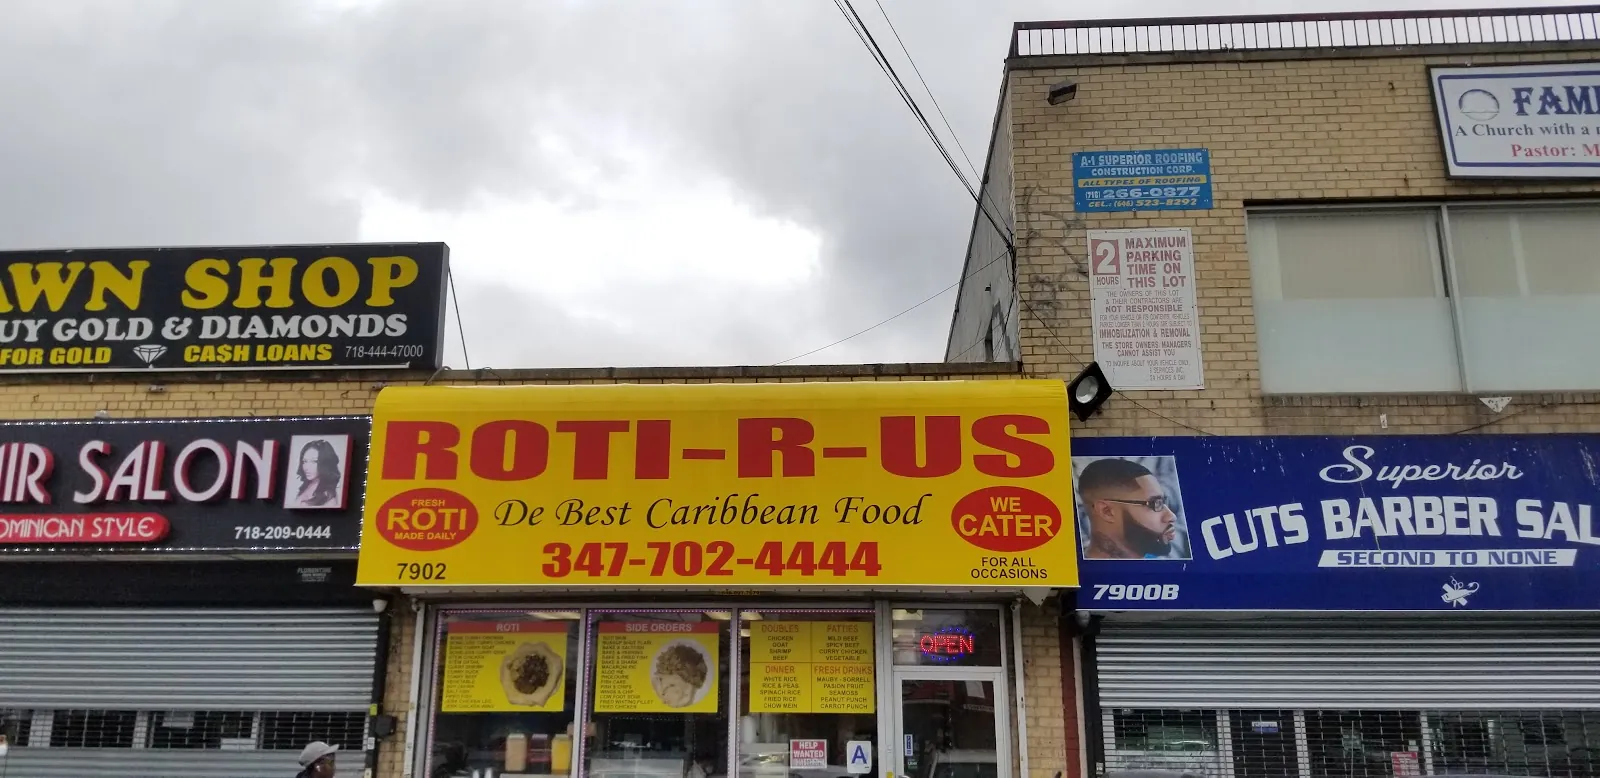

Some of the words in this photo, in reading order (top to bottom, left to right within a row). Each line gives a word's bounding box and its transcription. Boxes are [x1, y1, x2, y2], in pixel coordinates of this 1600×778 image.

[1455, 125, 1468, 137] A
[1472, 124, 1533, 136] Church
[1539, 123, 1575, 136] with
[1581, 126, 1590, 135] a
[1511, 144, 1576, 157] Pastor:
[1099, 153, 1153, 166] SUPERIOR
[1155, 152, 1203, 164] ROOFING
[1091, 166, 1163, 176] CONSTRUCTION
[1166, 165, 1196, 174] CORP.
[1102, 186, 1201, 199] 266-0877
[1136, 198, 1197, 206] 523-8292
[1125, 236, 1186, 249] MAXIMUM
[1096, 241, 1117, 274] 2
[1126, 250, 1182, 262] PARKING
[1126, 263, 1157, 275] TIME
[1163, 262, 1181, 274] ON
[0, 259, 150, 314] WN
[180, 256, 419, 309] SHOP
[1096, 276, 1120, 286] HOURS
[1127, 276, 1156, 288] THIS
[1162, 275, 1187, 288] LOT
[1119, 290, 1143, 298] OWNERS
[1155, 289, 1168, 297] THIS
[1168, 289, 1180, 297] LOT
[1129, 297, 1170, 305] CONTRACTORS
[1105, 305, 1122, 313] NOT
[1126, 304, 1183, 313] RESPONSIBLE
[52, 317, 154, 342] GOLD
[161, 316, 193, 341] &
[198, 313, 408, 340] DIAMONDS
[1099, 328, 1150, 339] IMMOBILIZATION
[1153, 328, 1158, 338] &
[1160, 327, 1191, 338] REMOVAL
[1115, 341, 1133, 349] STORE
[1161, 340, 1192, 348] MANAGERS
[0, 347, 44, 365] FOR
[49, 346, 112, 364] GOLD
[183, 343, 250, 363] CA$H
[255, 343, 333, 362] LOANS
[345, 344, 424, 359] 718-444-47000
[1117, 349, 1139, 357] CANNOT
[1141, 349, 1161, 357] ASSIST
[1164, 348, 1176, 356] YOU
[380, 413, 1056, 482] ROTI-R-US
[0, 442, 51, 504] IR
[73, 438, 279, 503] SALON
[1318, 445, 1524, 489] Superior
[411, 498, 446, 507] FRESH
[989, 496, 1022, 513] WE
[494, 498, 545, 527] De
[555, 498, 633, 527] Best
[645, 492, 820, 530] Caribbean
[834, 493, 933, 526] Food
[386, 508, 467, 531] ROTI
[958, 513, 1055, 538] CATER
[92, 516, 156, 538] STYLE
[234, 525, 331, 540] 718-209-0444
[1200, 502, 1310, 560] CUTS
[1320, 496, 1502, 540] BARBER
[1515, 498, 1600, 545] SAL
[394, 531, 424, 541] MADE
[427, 531, 457, 541] DAILY
[541, 540, 882, 578] 347-702-4444
[981, 556, 1008, 567] FOR
[1011, 556, 1036, 567] ALL
[1337, 551, 1436, 566] SECOND
[1445, 551, 1478, 566] TO
[1488, 550, 1557, 565] NONE
[396, 562, 447, 580] 7902
[970, 568, 1048, 579] OCCASIONS
[1092, 583, 1180, 601] 7900B
[496, 623, 520, 632] ROTI
[625, 623, 648, 632] SIDE
[650, 623, 692, 632] ORDERS
[761, 624, 799, 633] DOUBLES
[826, 624, 859, 633] PATTIES
[920, 634, 975, 654] OPEN
[765, 665, 795, 674] DINNER
[814, 665, 841, 675] FRESH
[842, 665, 873, 675] DRINKS
[799, 741, 818, 749] HELP
[793, 749, 825, 758] WANTED
[850, 744, 868, 765] A
